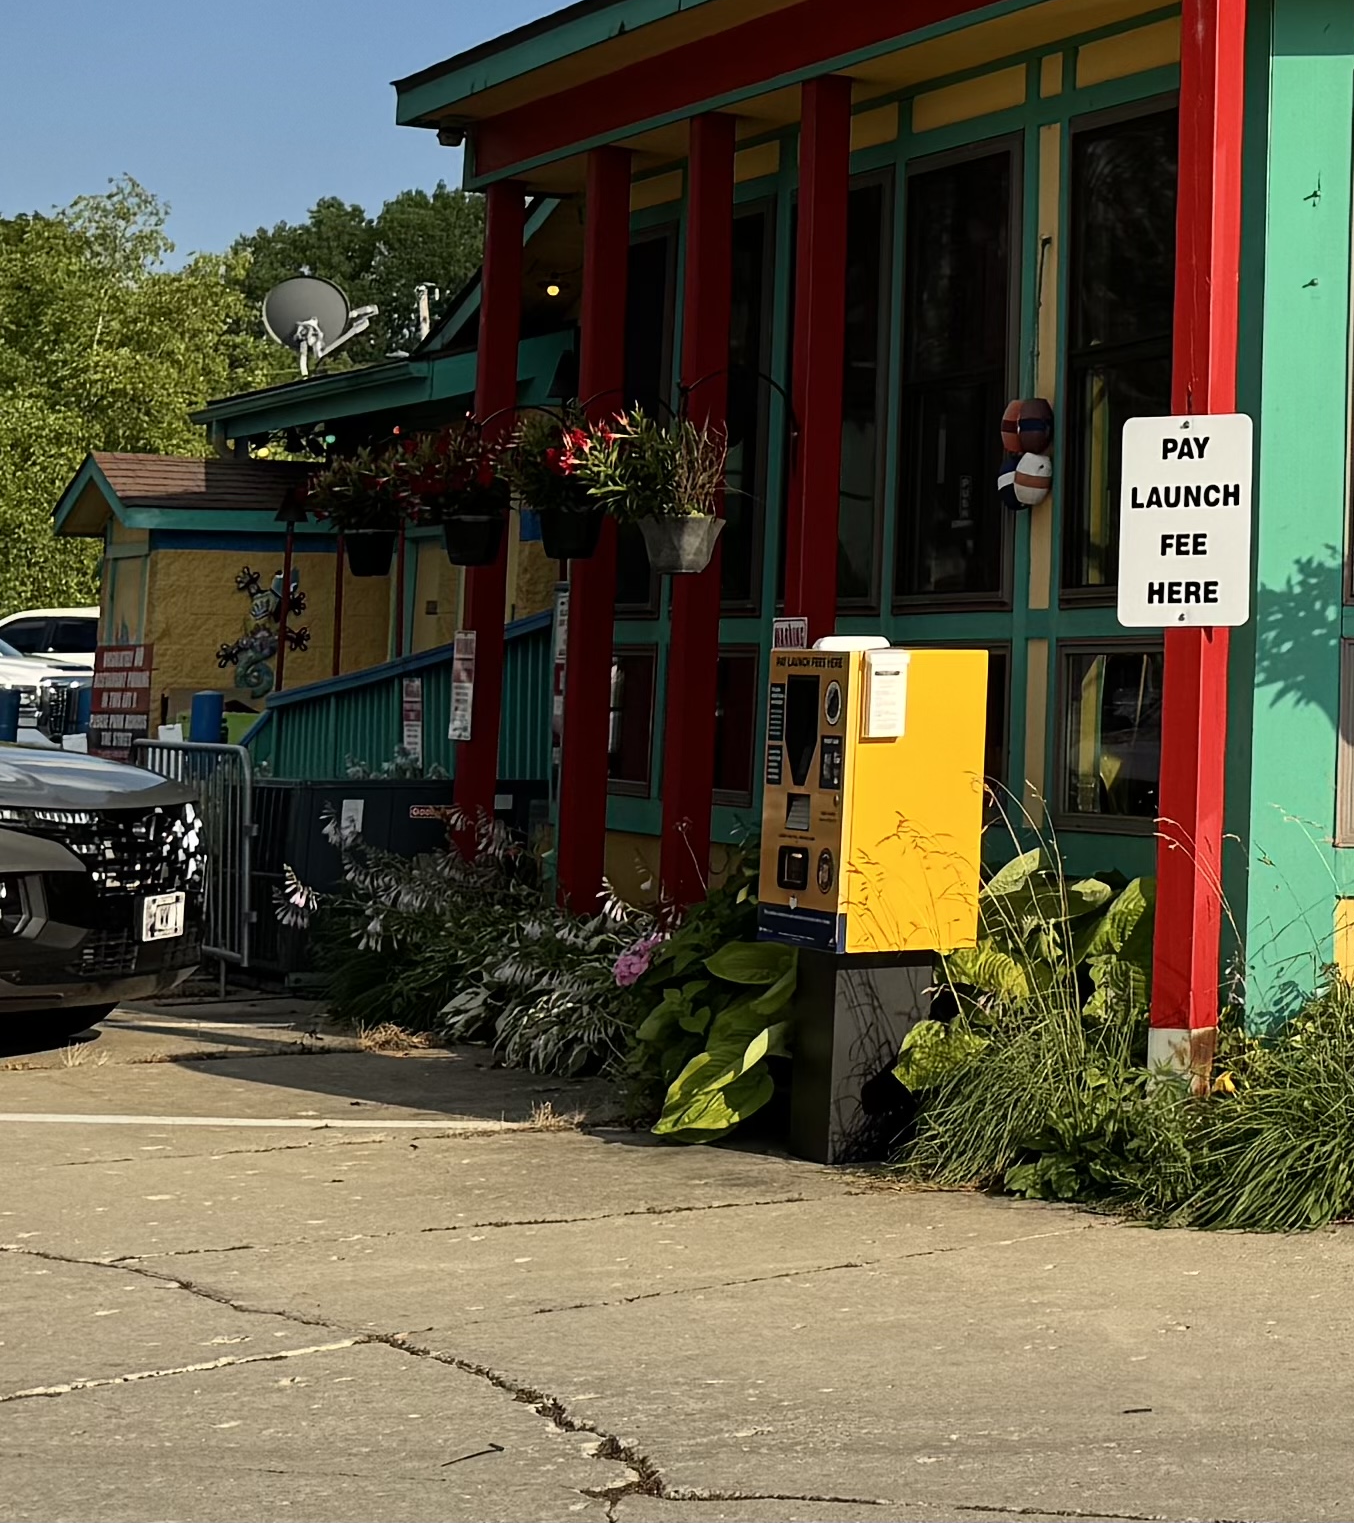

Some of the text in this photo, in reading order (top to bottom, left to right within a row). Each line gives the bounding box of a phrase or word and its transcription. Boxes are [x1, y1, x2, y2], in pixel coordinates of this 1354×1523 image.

[1162, 437, 1210, 460] PAY
[1131, 483, 1240, 509] LAUNCH
[1160, 533, 1207, 557] FEE
[1147, 581, 1219, 605] HERE
